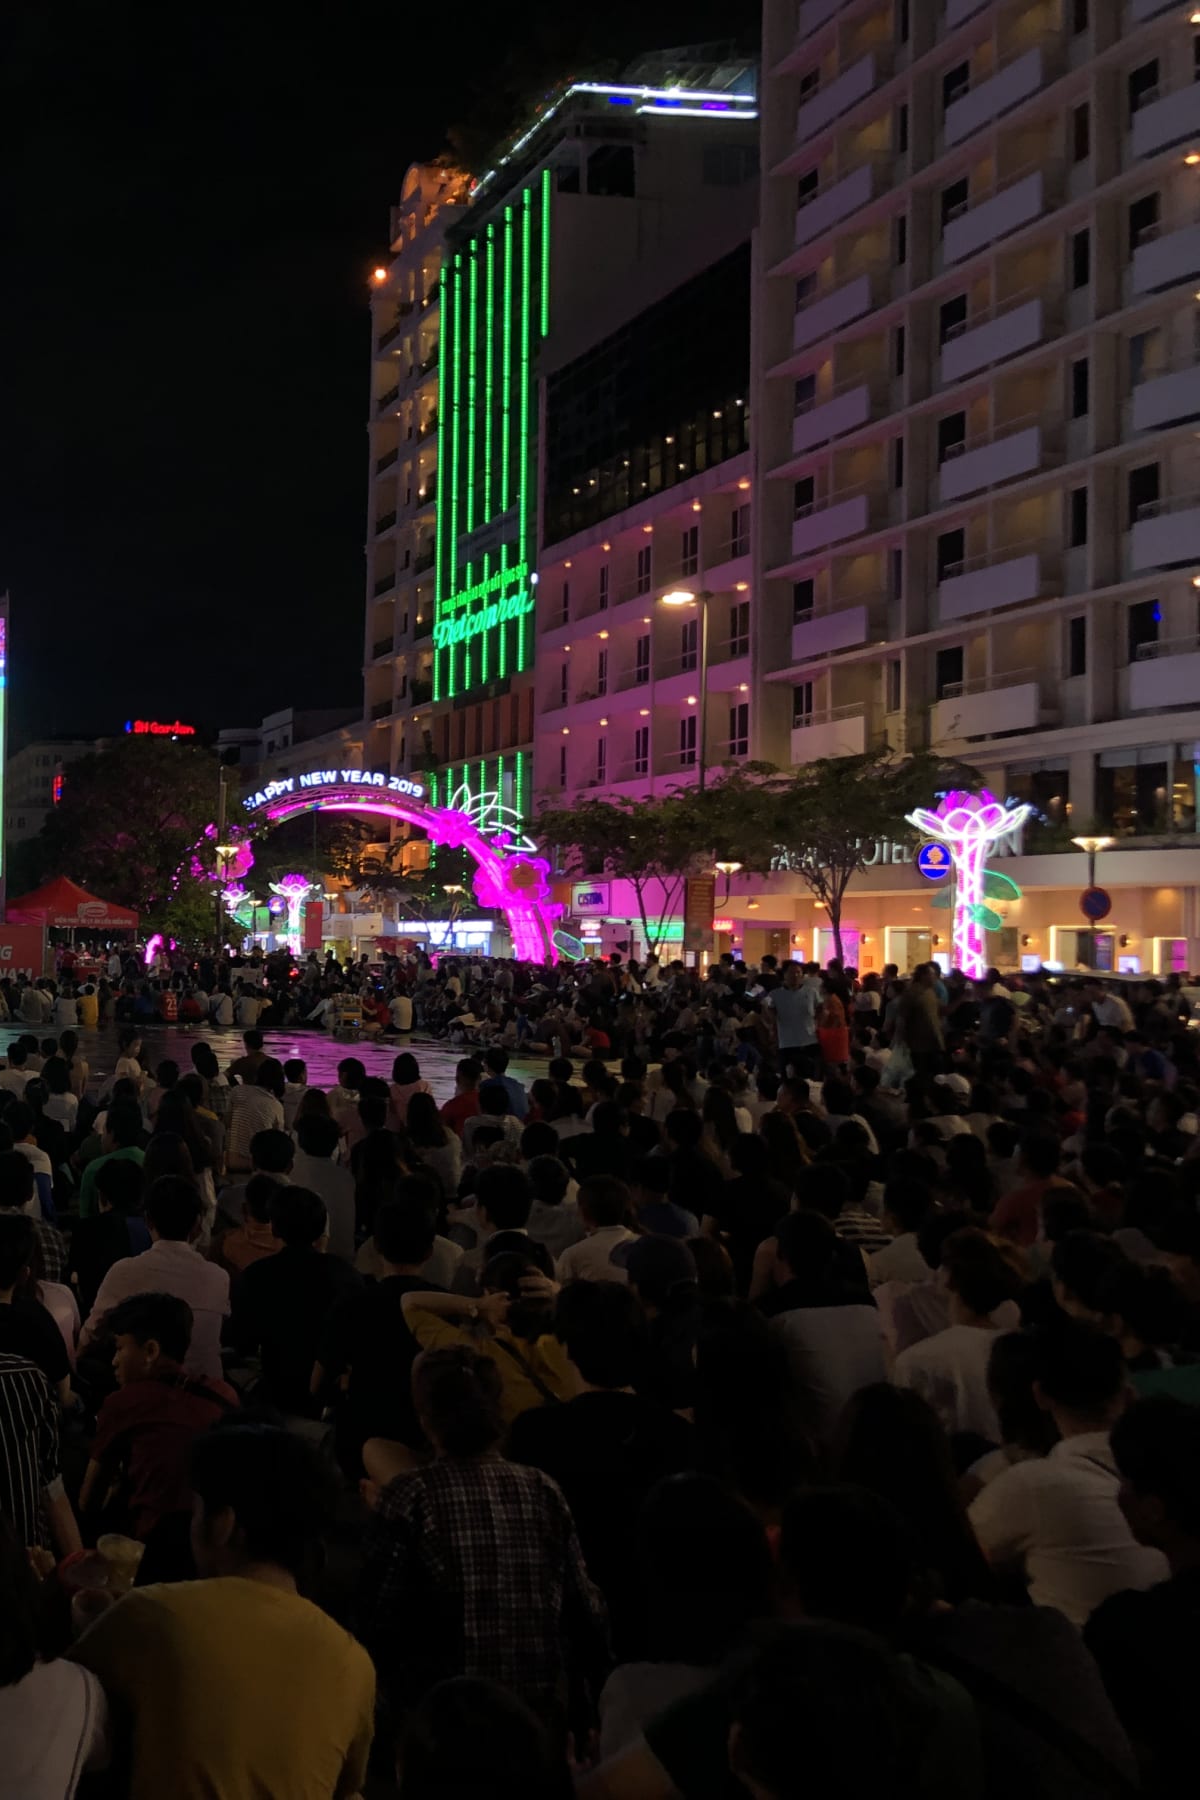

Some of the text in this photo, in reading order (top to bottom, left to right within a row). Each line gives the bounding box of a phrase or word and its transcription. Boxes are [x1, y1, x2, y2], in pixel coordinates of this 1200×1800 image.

[300, 771, 338, 788] NEW
[341, 769, 385, 787] YEAR
[388, 777, 424, 798] 2019
